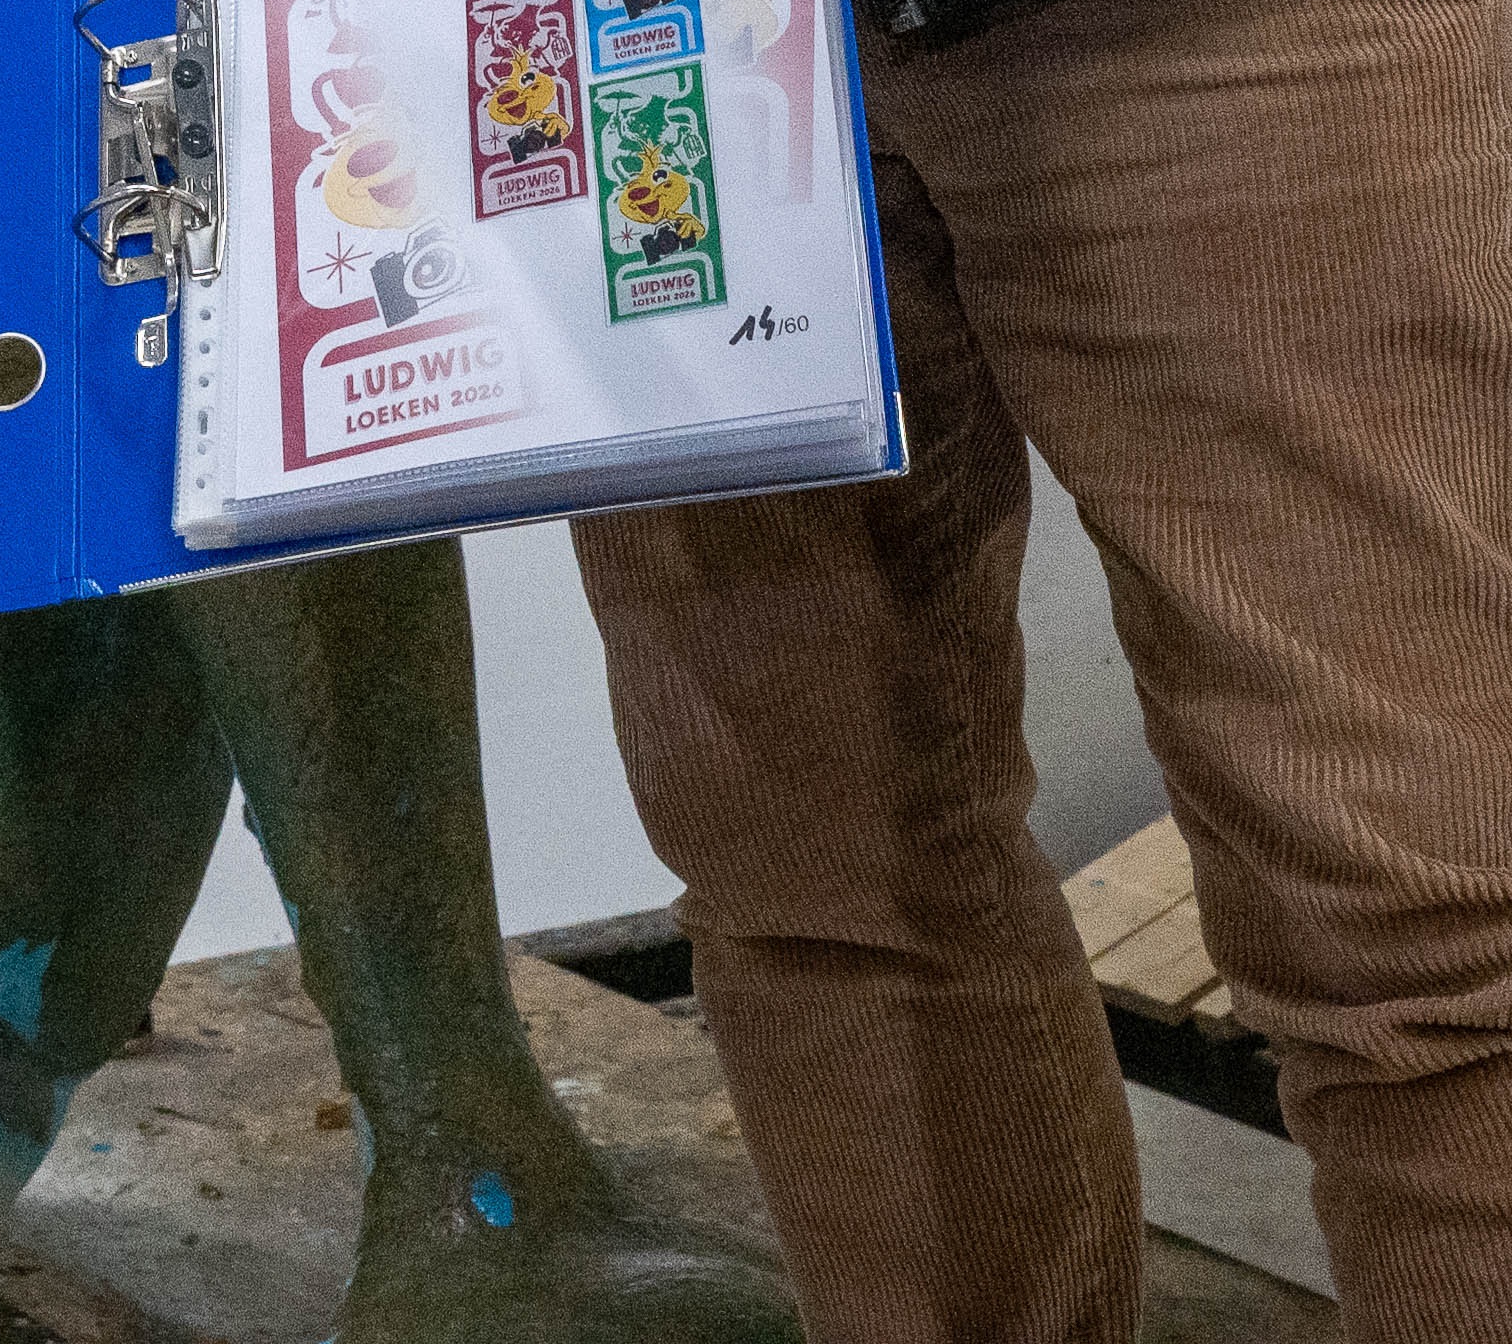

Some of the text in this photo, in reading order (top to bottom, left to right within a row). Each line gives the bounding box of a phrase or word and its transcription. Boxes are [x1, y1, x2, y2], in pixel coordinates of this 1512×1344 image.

[613, 25, 676, 51] LUDWIG
[615, 41, 677, 60] LOEKEN 2026
[497, 169, 561, 196] LUDWIG
[498, 185, 561, 206] LOEKEN 2026
[631, 273, 696, 299] LUDWIG
[633, 290, 696, 307] LOEKEN 2026
[344, 338, 505, 406] LUDWIG
[345, 382, 505, 434] LOEKEN 2026
